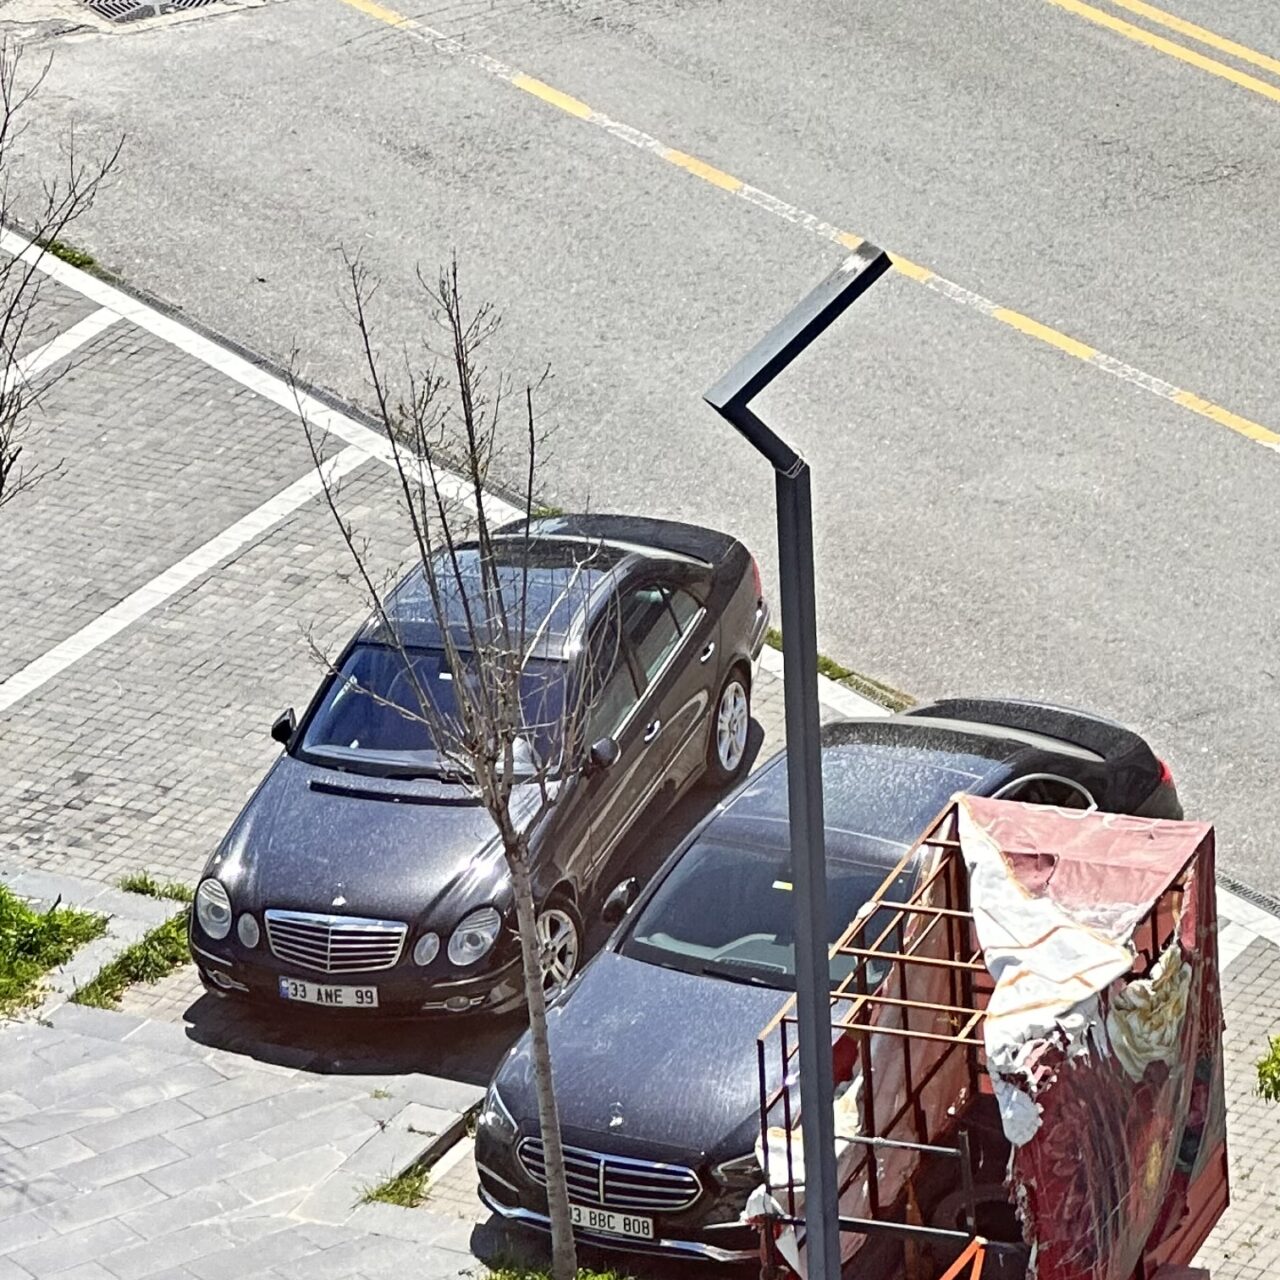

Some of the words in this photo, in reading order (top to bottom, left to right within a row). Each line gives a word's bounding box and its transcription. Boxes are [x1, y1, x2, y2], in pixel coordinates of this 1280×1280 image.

[289, 982, 307, 999] 33
[316, 988, 343, 1004] ANE
[354, 989, 374, 1004] 99
[589, 1210, 616, 1230] BBC
[623, 1216, 650, 1236] 808
